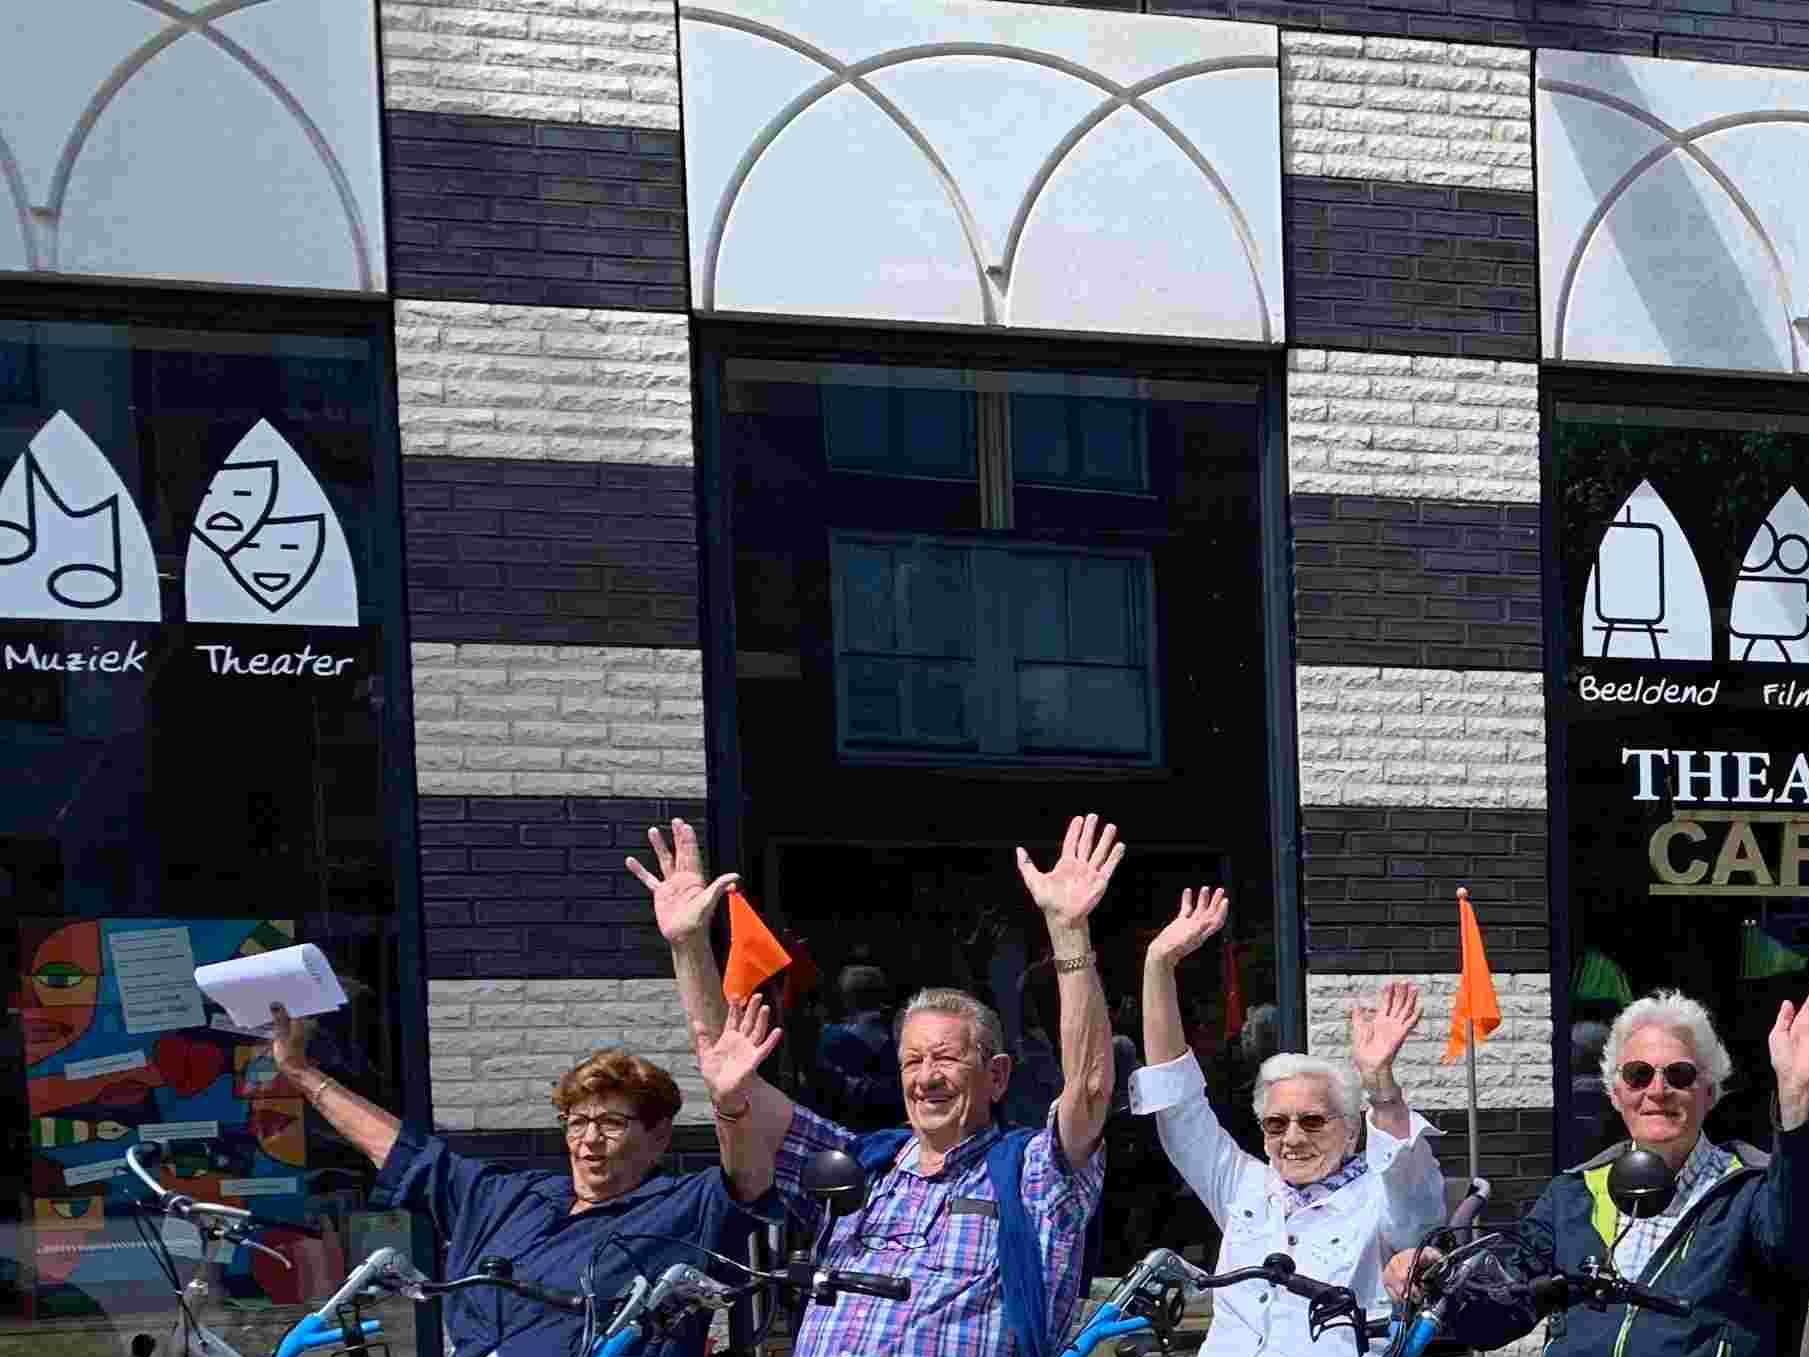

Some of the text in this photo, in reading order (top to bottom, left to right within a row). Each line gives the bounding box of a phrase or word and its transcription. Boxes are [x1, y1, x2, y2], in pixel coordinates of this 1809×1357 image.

[3, 640, 148, 672] Muziek
[194, 644, 354, 676] Theater
[1579, 675, 1721, 706] Beeldend
